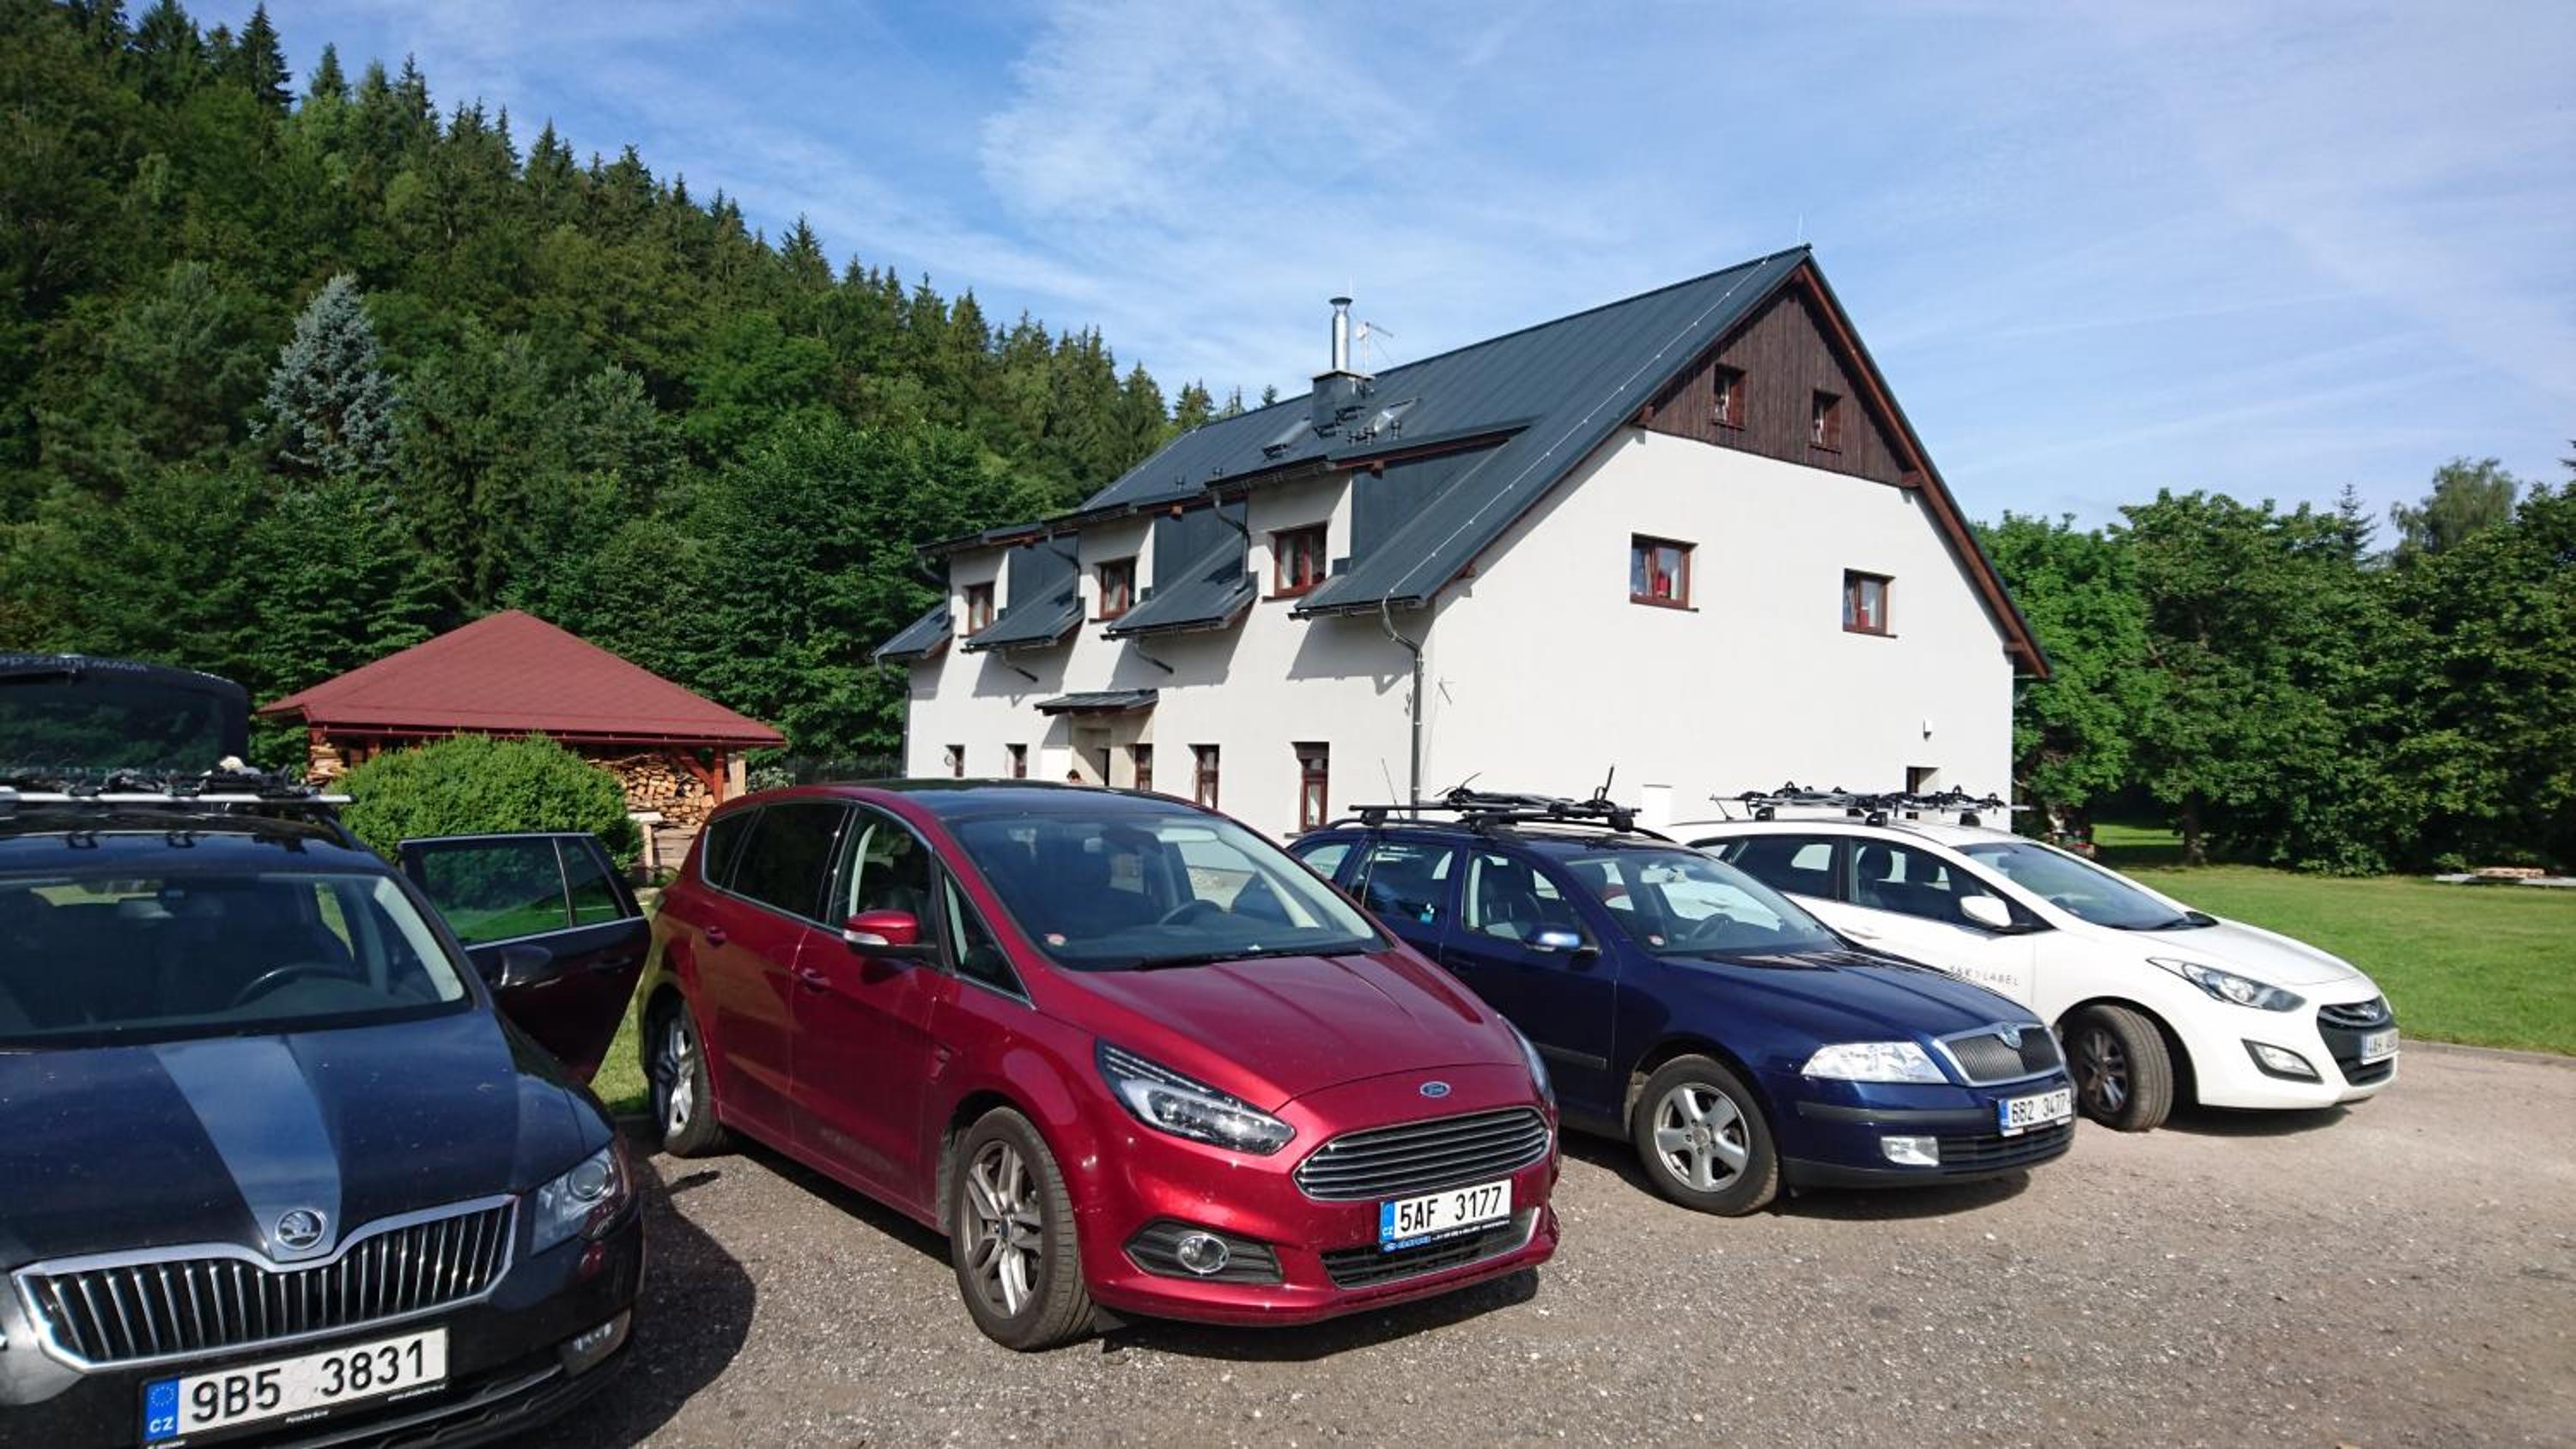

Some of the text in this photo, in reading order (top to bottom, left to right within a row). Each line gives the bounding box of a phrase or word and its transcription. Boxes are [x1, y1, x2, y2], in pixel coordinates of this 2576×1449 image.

[2012, 1093, 2065, 1123] 6B2 3477
[1400, 1186, 1502, 1232] 5AF 3177
[1382, 1226, 1393, 1236] CZ
[191, 1339, 423, 1423] 9B5 3831
[149, 1416, 173, 1433] CZ
